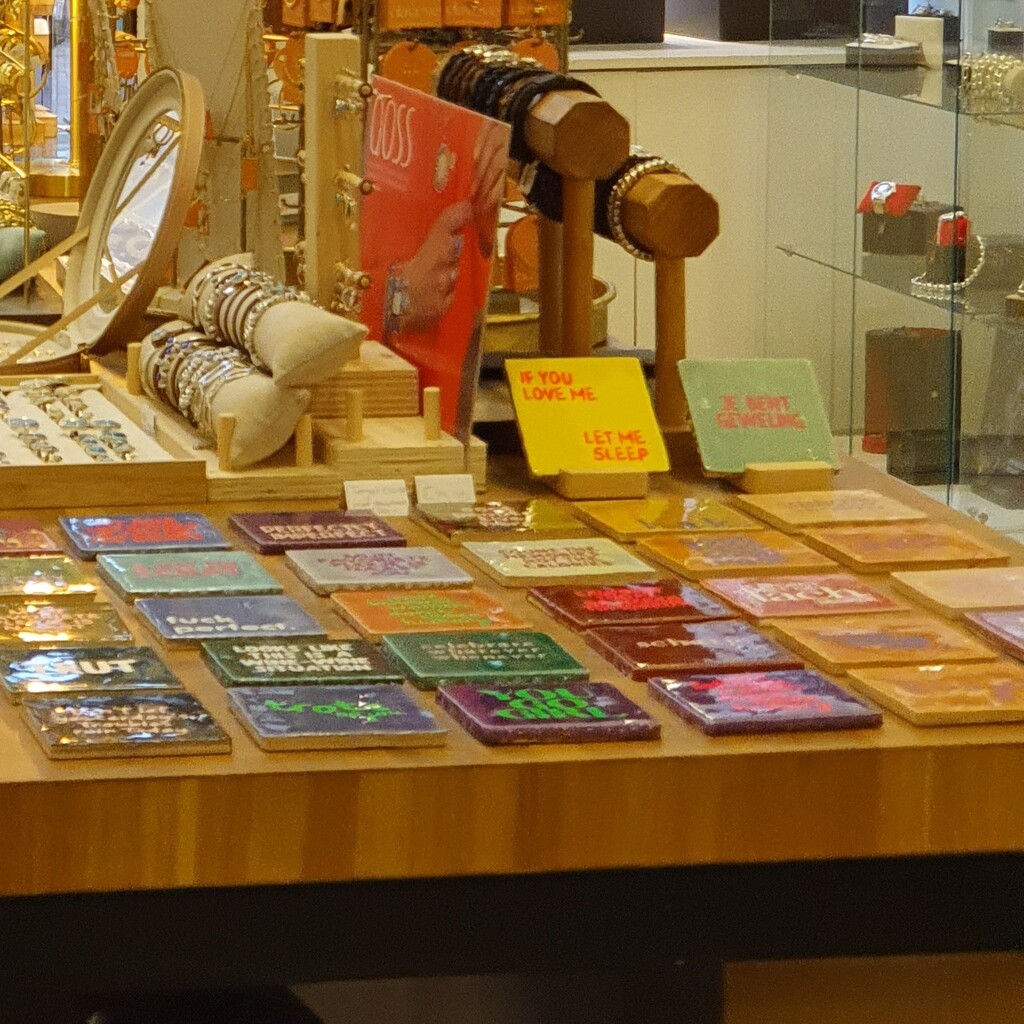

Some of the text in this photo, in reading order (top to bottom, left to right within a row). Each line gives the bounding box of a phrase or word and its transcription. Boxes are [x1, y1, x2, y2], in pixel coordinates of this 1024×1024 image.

[520, 371, 573, 386] IF YOU
[523, 387, 598, 401] LOVE ME
[584, 430, 647, 445] LET ME
[593, 447, 649, 461] SLEEP
